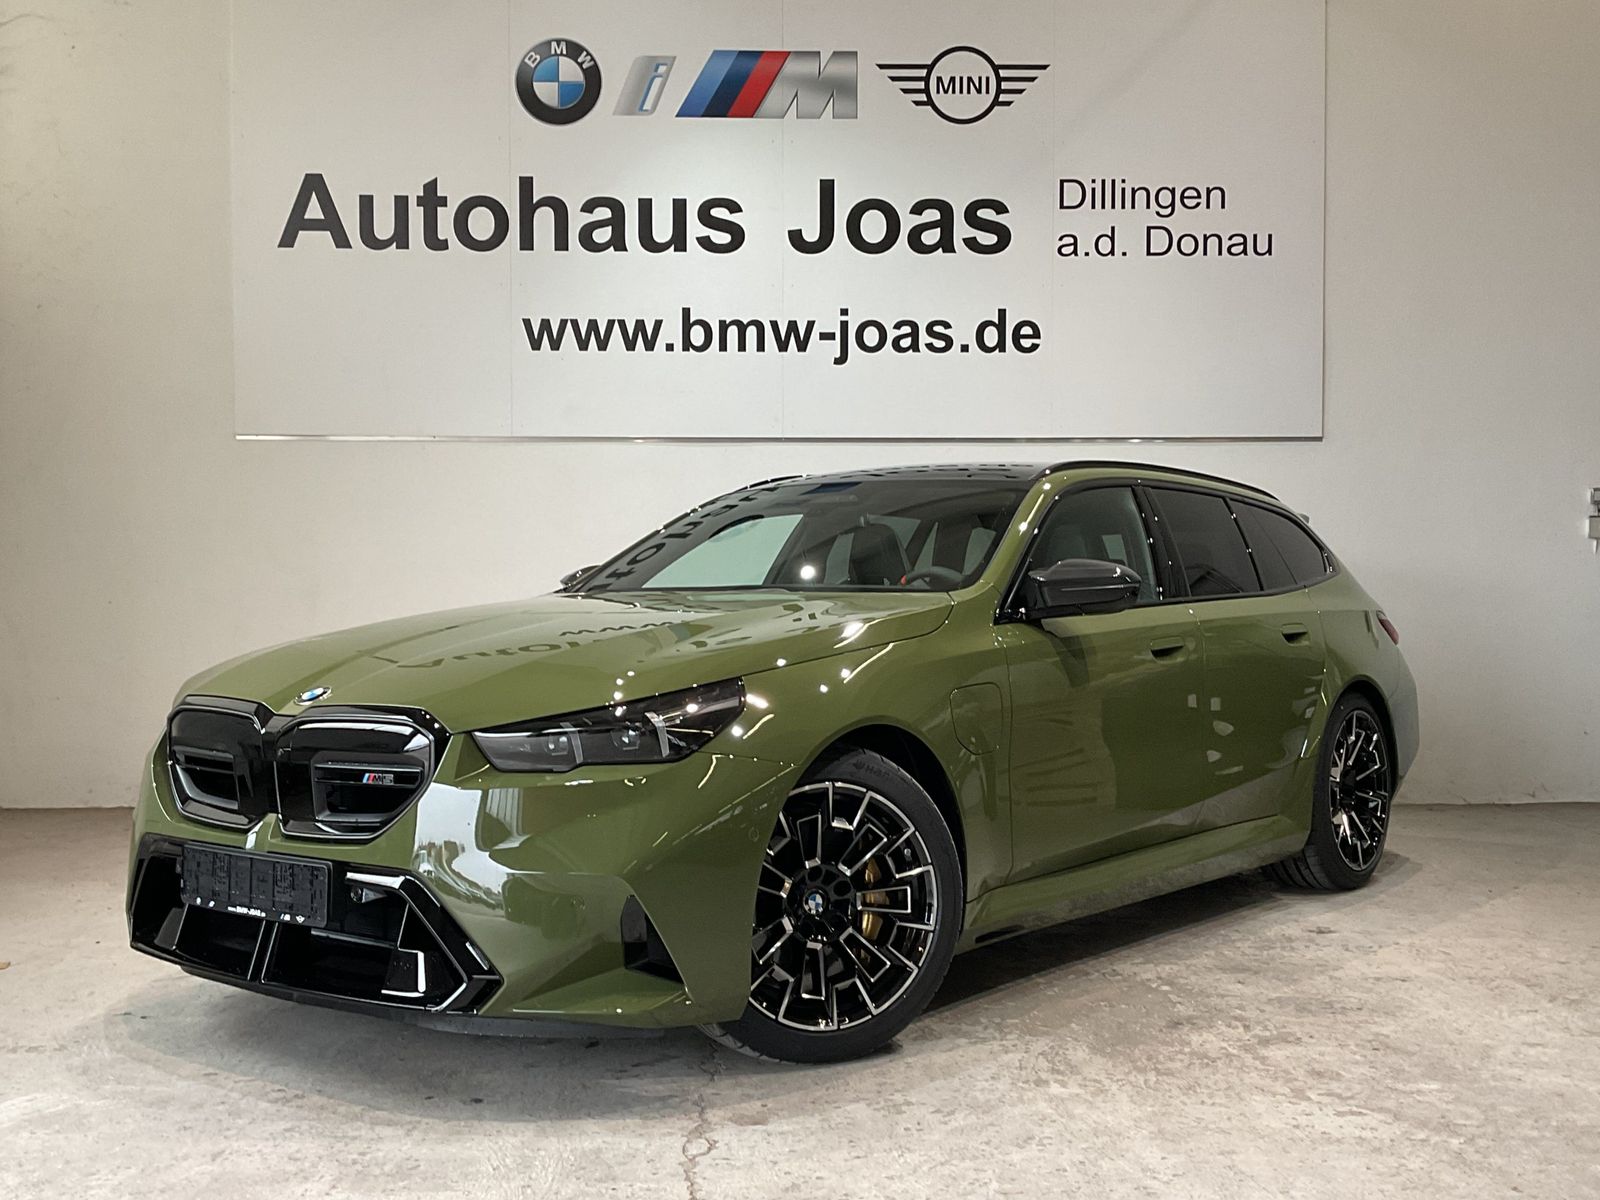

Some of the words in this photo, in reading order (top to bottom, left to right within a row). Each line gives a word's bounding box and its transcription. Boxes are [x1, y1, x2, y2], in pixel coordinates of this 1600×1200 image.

[524, 41, 595, 69] BMW
[750, 50, 859, 119] M
[935, 75, 991, 95] MINI
[277, 173, 746, 254] Autohaus
[787, 178, 1012, 256] Joas
[1059, 178, 1226, 219] Dillingen
[1057, 225, 1127, 257] a.d.
[1145, 225, 1273, 257] Donau
[521, 307, 1042, 366] www.bmw-joas.de
